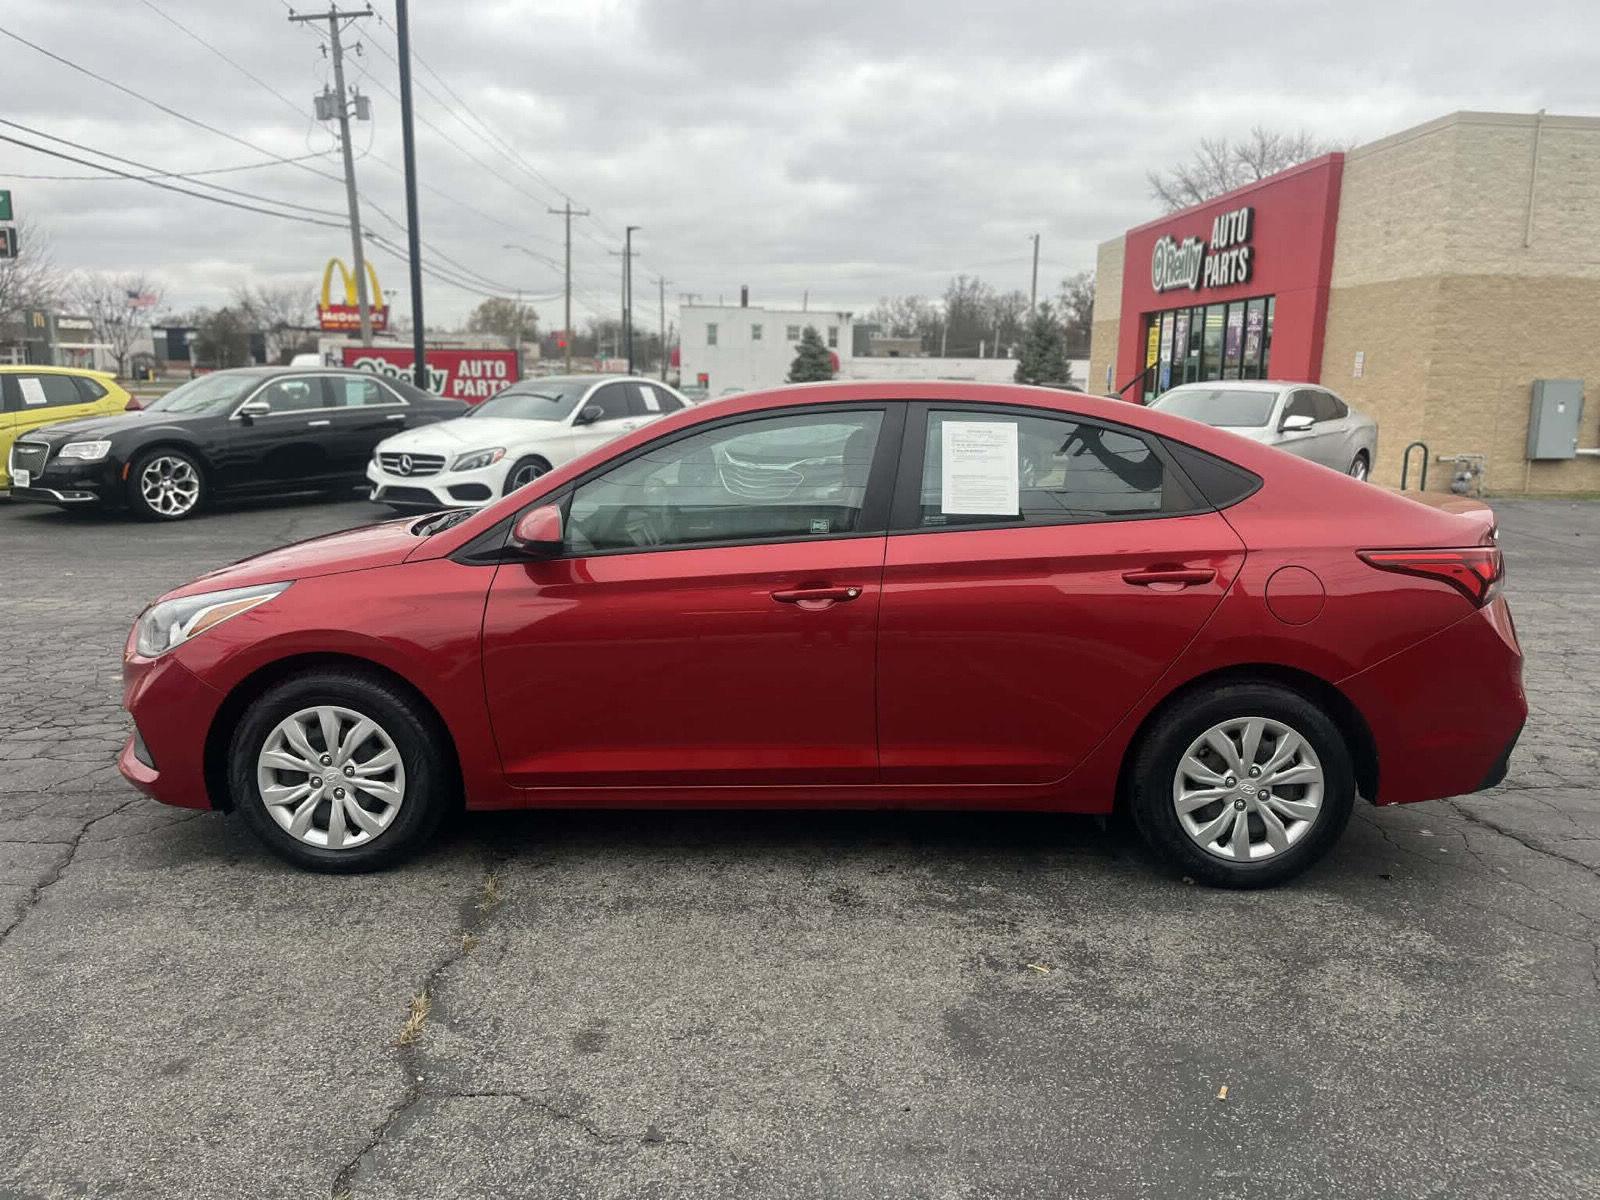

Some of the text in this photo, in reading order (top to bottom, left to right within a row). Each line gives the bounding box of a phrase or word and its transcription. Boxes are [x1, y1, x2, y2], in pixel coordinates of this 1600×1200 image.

[1211, 207, 1249, 249] AUTO
[1151, 236, 1205, 290] O'Reilly
[1204, 247, 1249, 287] PARTS
[321, 311, 385, 322] McDond's
[458, 360, 507, 378] AUTO
